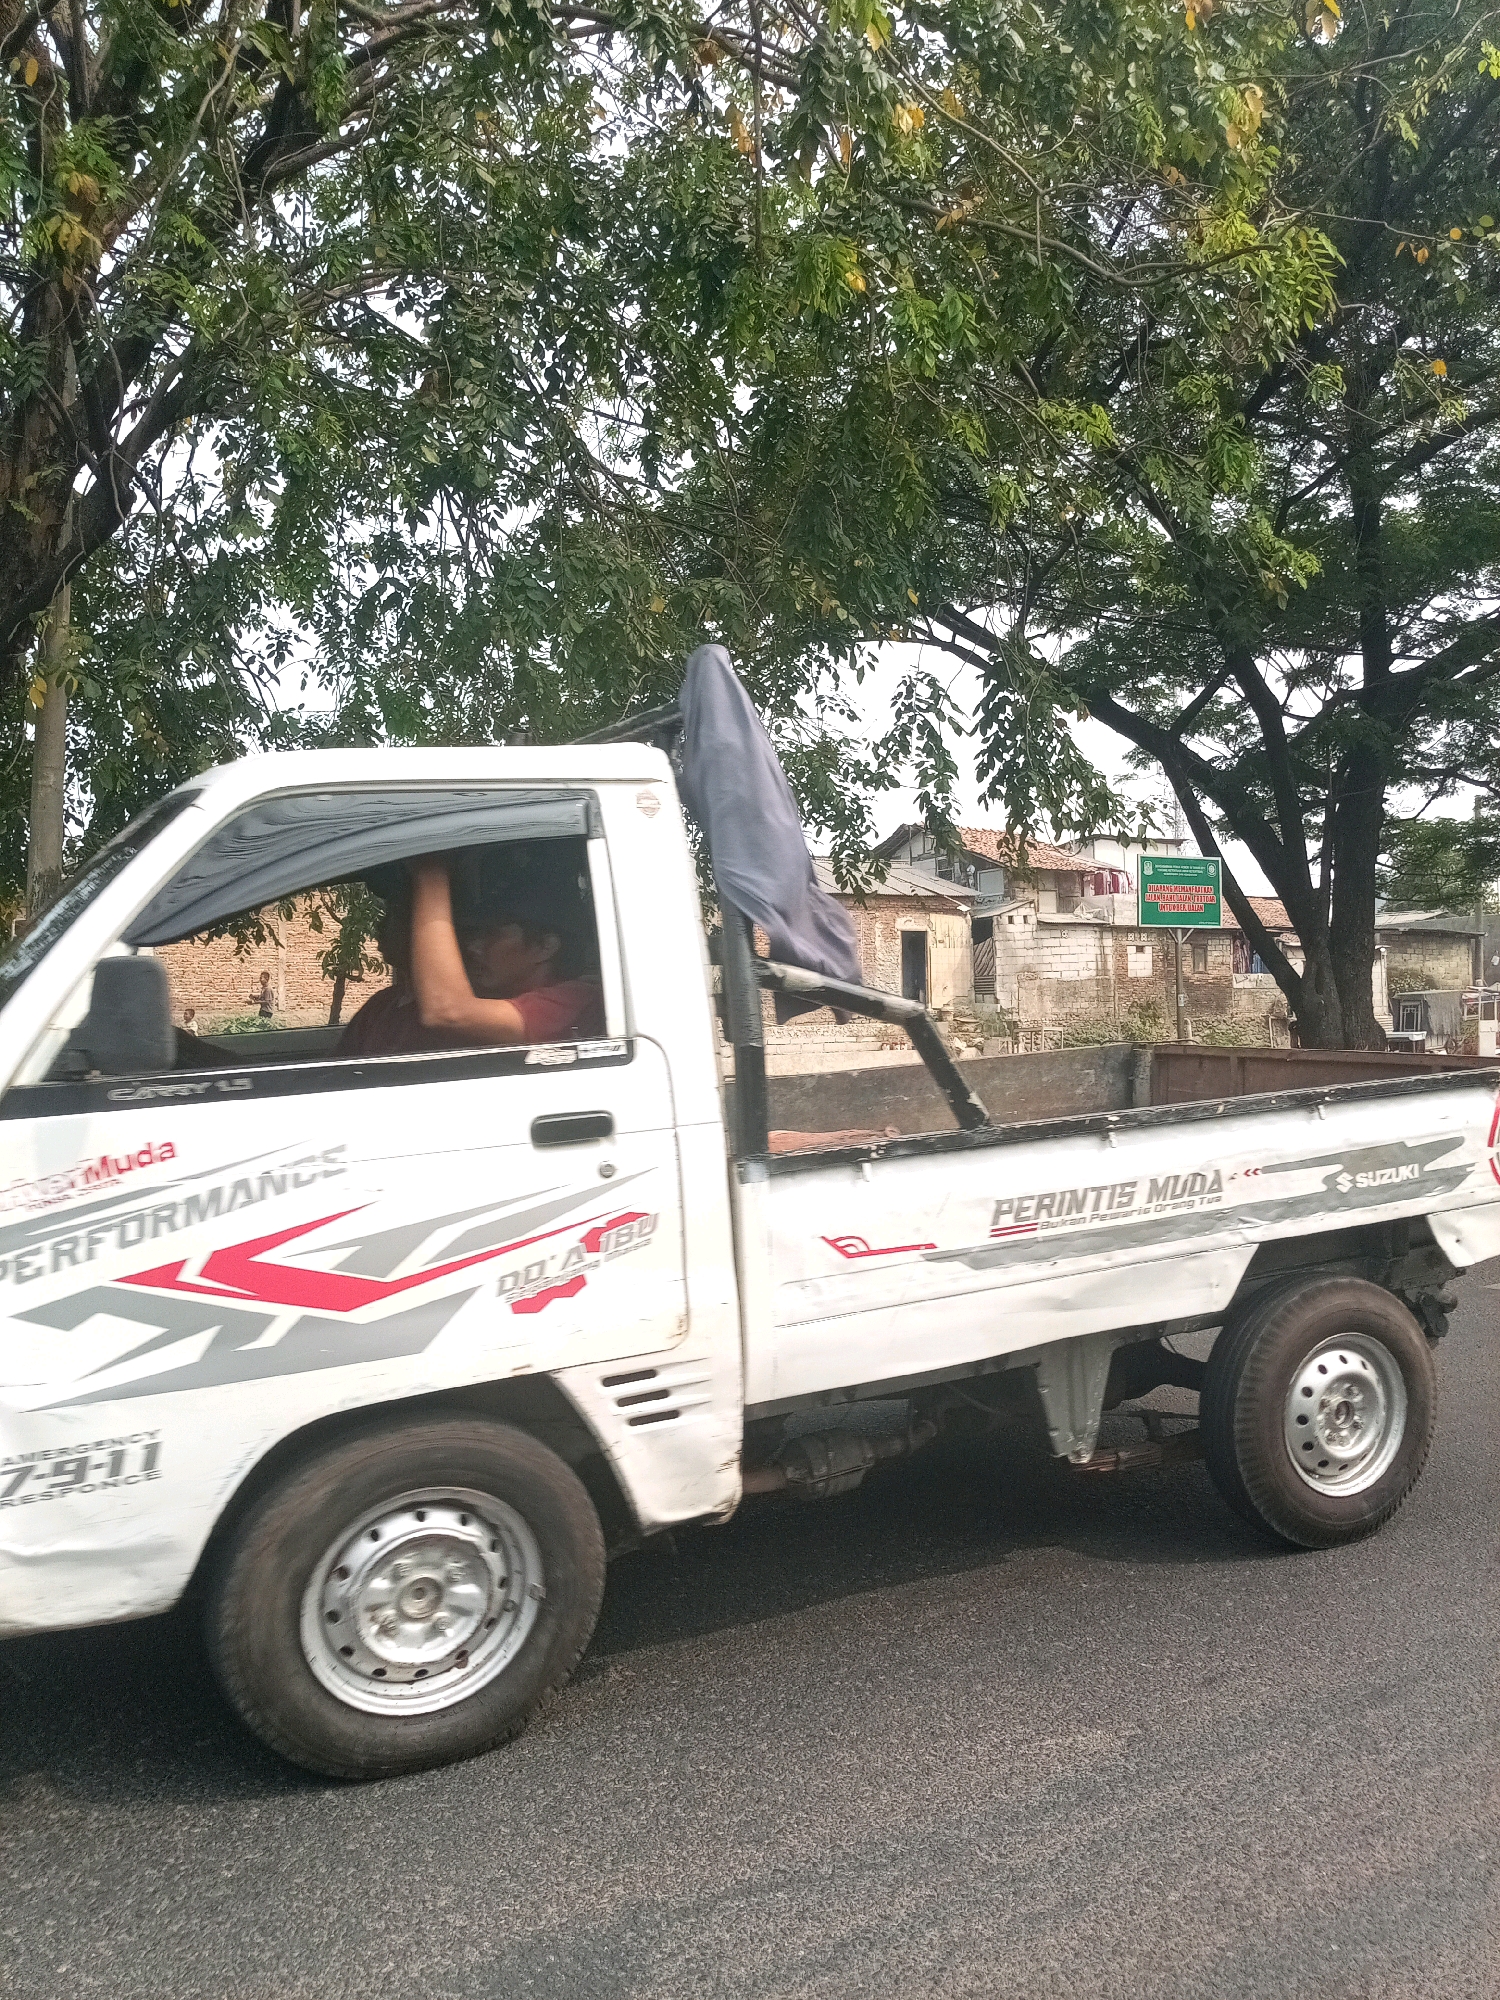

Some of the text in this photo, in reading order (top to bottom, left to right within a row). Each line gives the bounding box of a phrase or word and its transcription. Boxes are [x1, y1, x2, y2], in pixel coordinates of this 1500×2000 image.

[1355, 1163, 1420, 1188] SUZUKI
[990, 1169, 1224, 1226] PERINTIS MUDA
[1040, 1216, 1086, 1230] Bukan
[1154, 1198, 1196, 1213] Orang
[1198, 1195, 1222, 1206] Tua
[0, 1469, 163, 1510] RESPONCE
